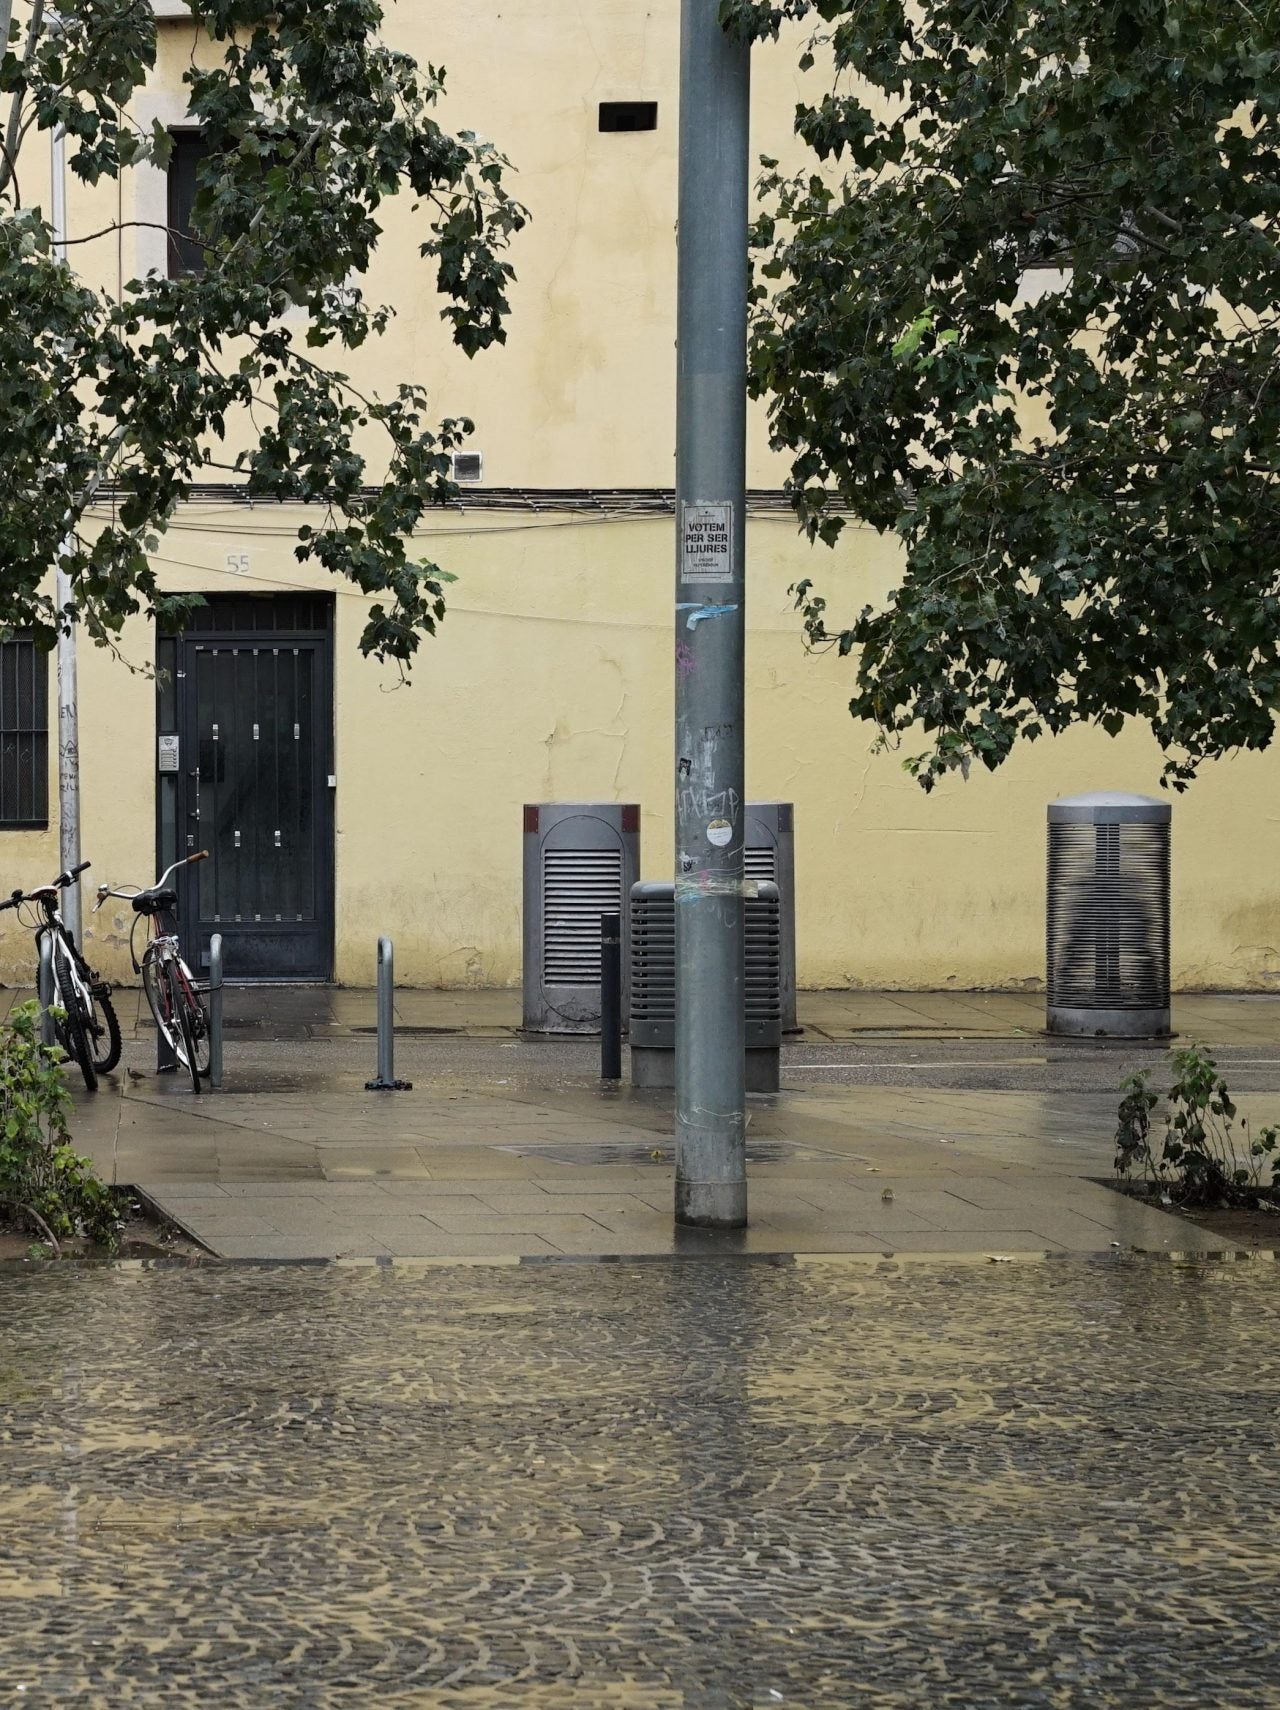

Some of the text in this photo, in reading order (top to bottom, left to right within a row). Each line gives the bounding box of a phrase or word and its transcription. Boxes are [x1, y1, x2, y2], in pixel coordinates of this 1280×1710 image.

[688, 523, 725, 532] VOTEM
[685, 533, 728, 543] PER SER
[227, 555, 249, 573] 55
